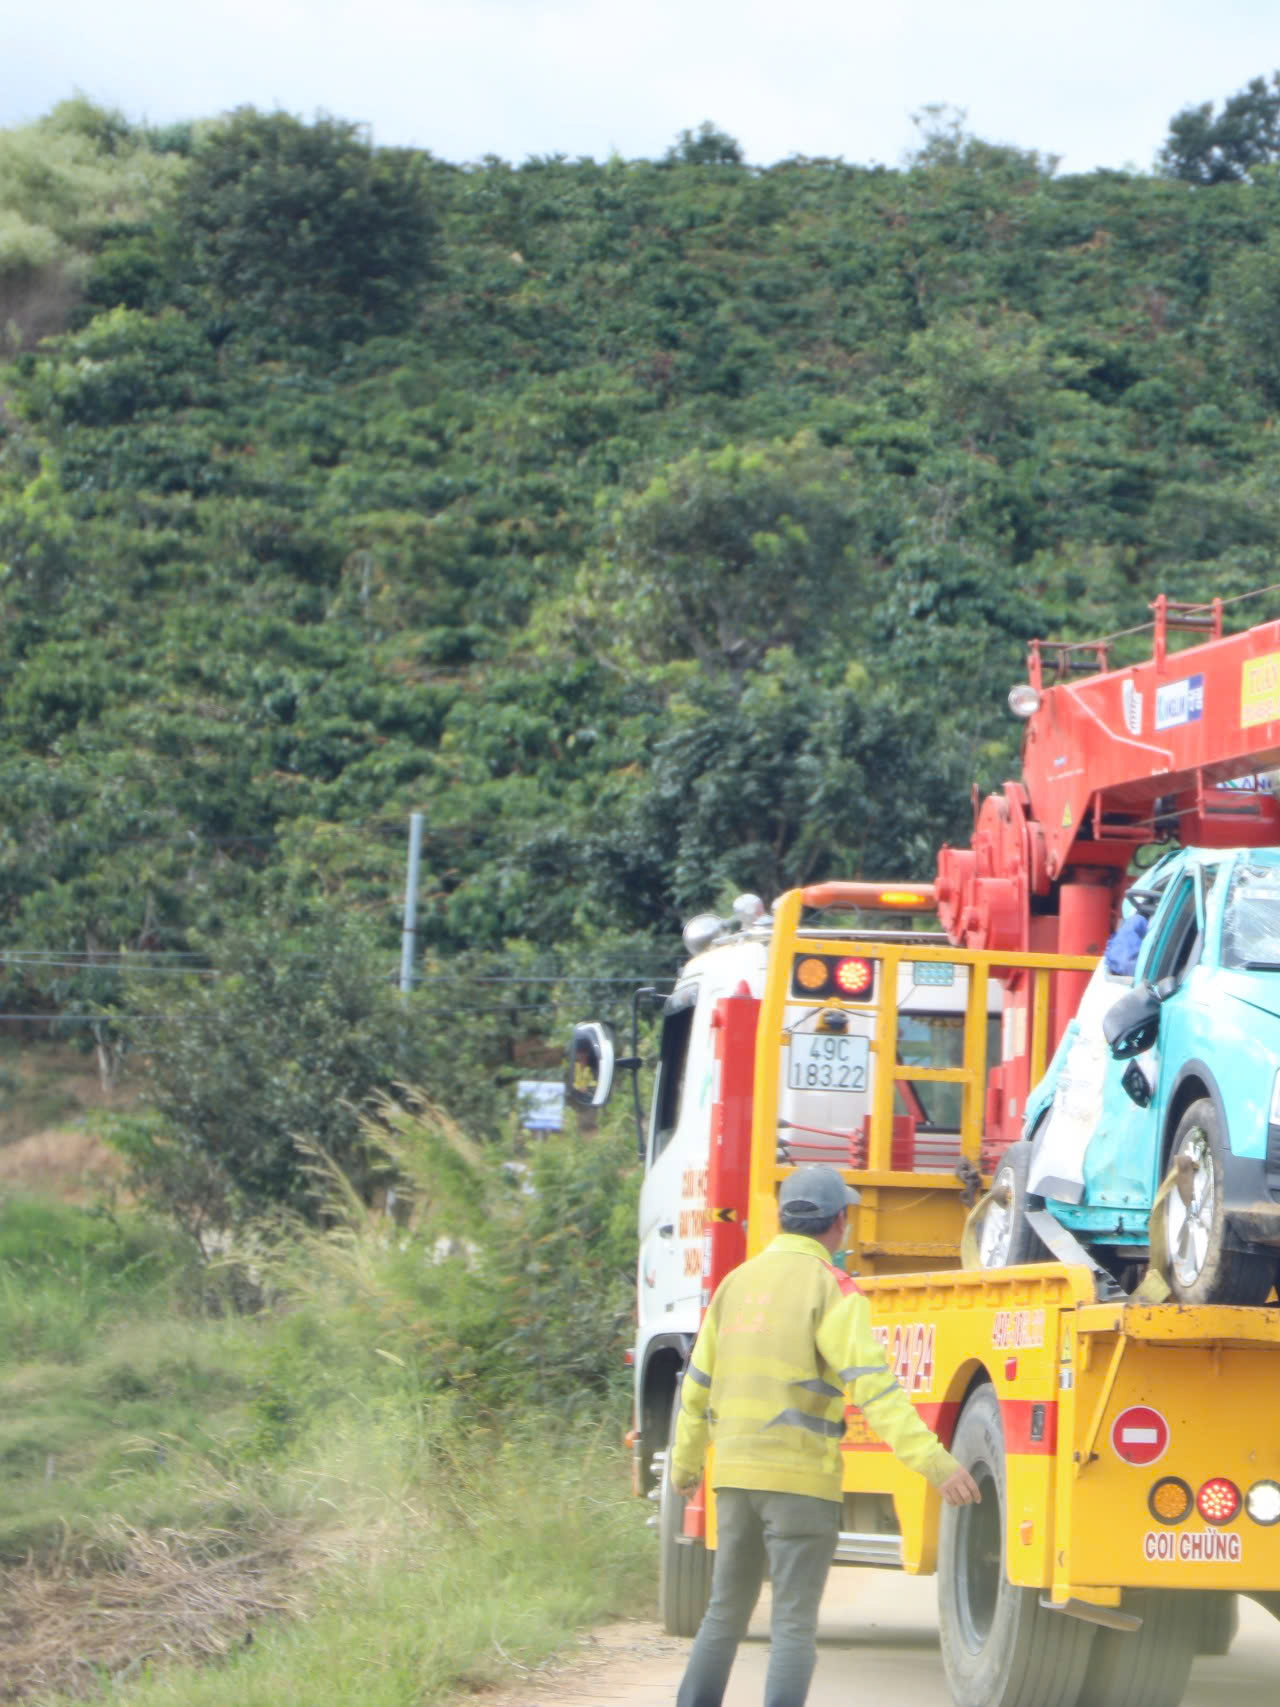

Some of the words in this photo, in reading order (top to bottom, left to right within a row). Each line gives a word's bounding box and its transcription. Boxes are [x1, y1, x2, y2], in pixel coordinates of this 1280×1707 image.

[809, 1037, 849, 1061] 49C
[792, 1062, 864, 1088] 183.22
[1145, 1533, 1174, 1559] COI
[1180, 1528, 1240, 1560] CHỪNG
